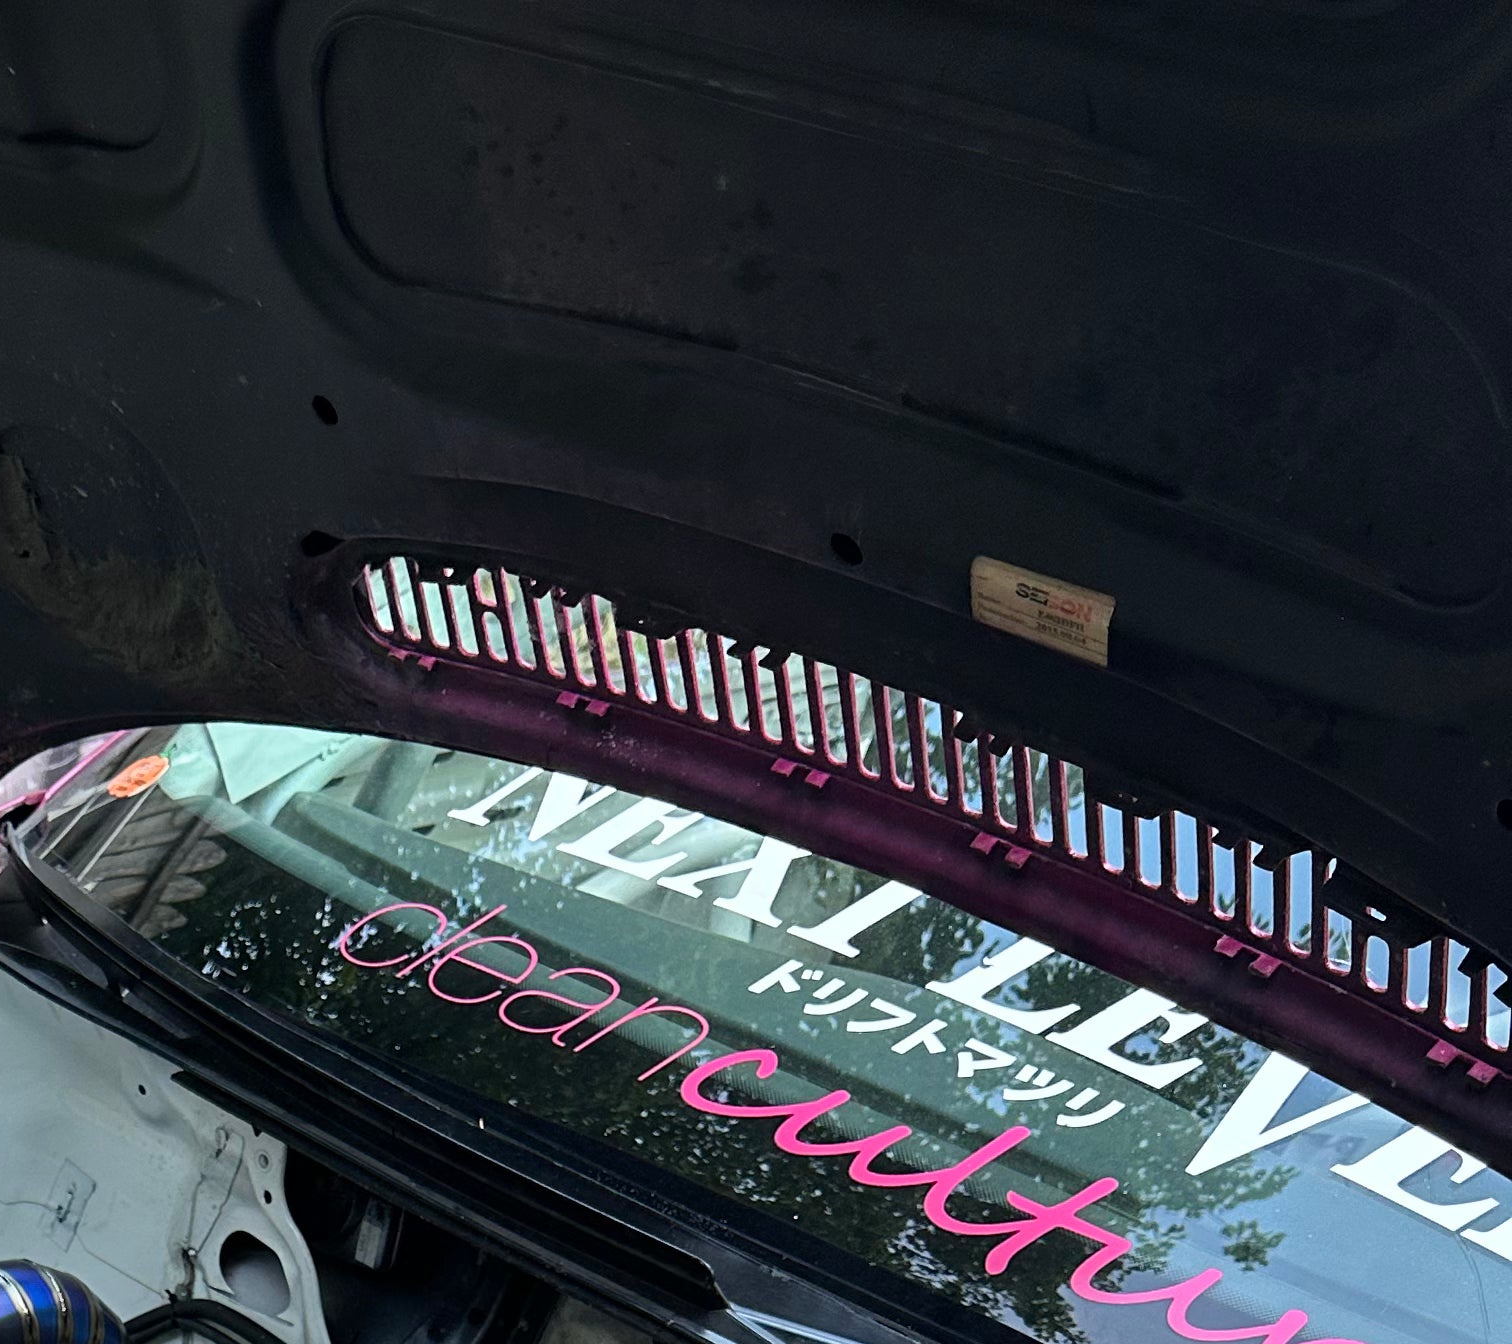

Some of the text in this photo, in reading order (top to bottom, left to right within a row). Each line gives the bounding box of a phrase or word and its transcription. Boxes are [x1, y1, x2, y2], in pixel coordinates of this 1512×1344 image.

[447, 765, 1512, 1263] NEXT LEVE
[747, 959, 1126, 1128] ドリフトマツリ
